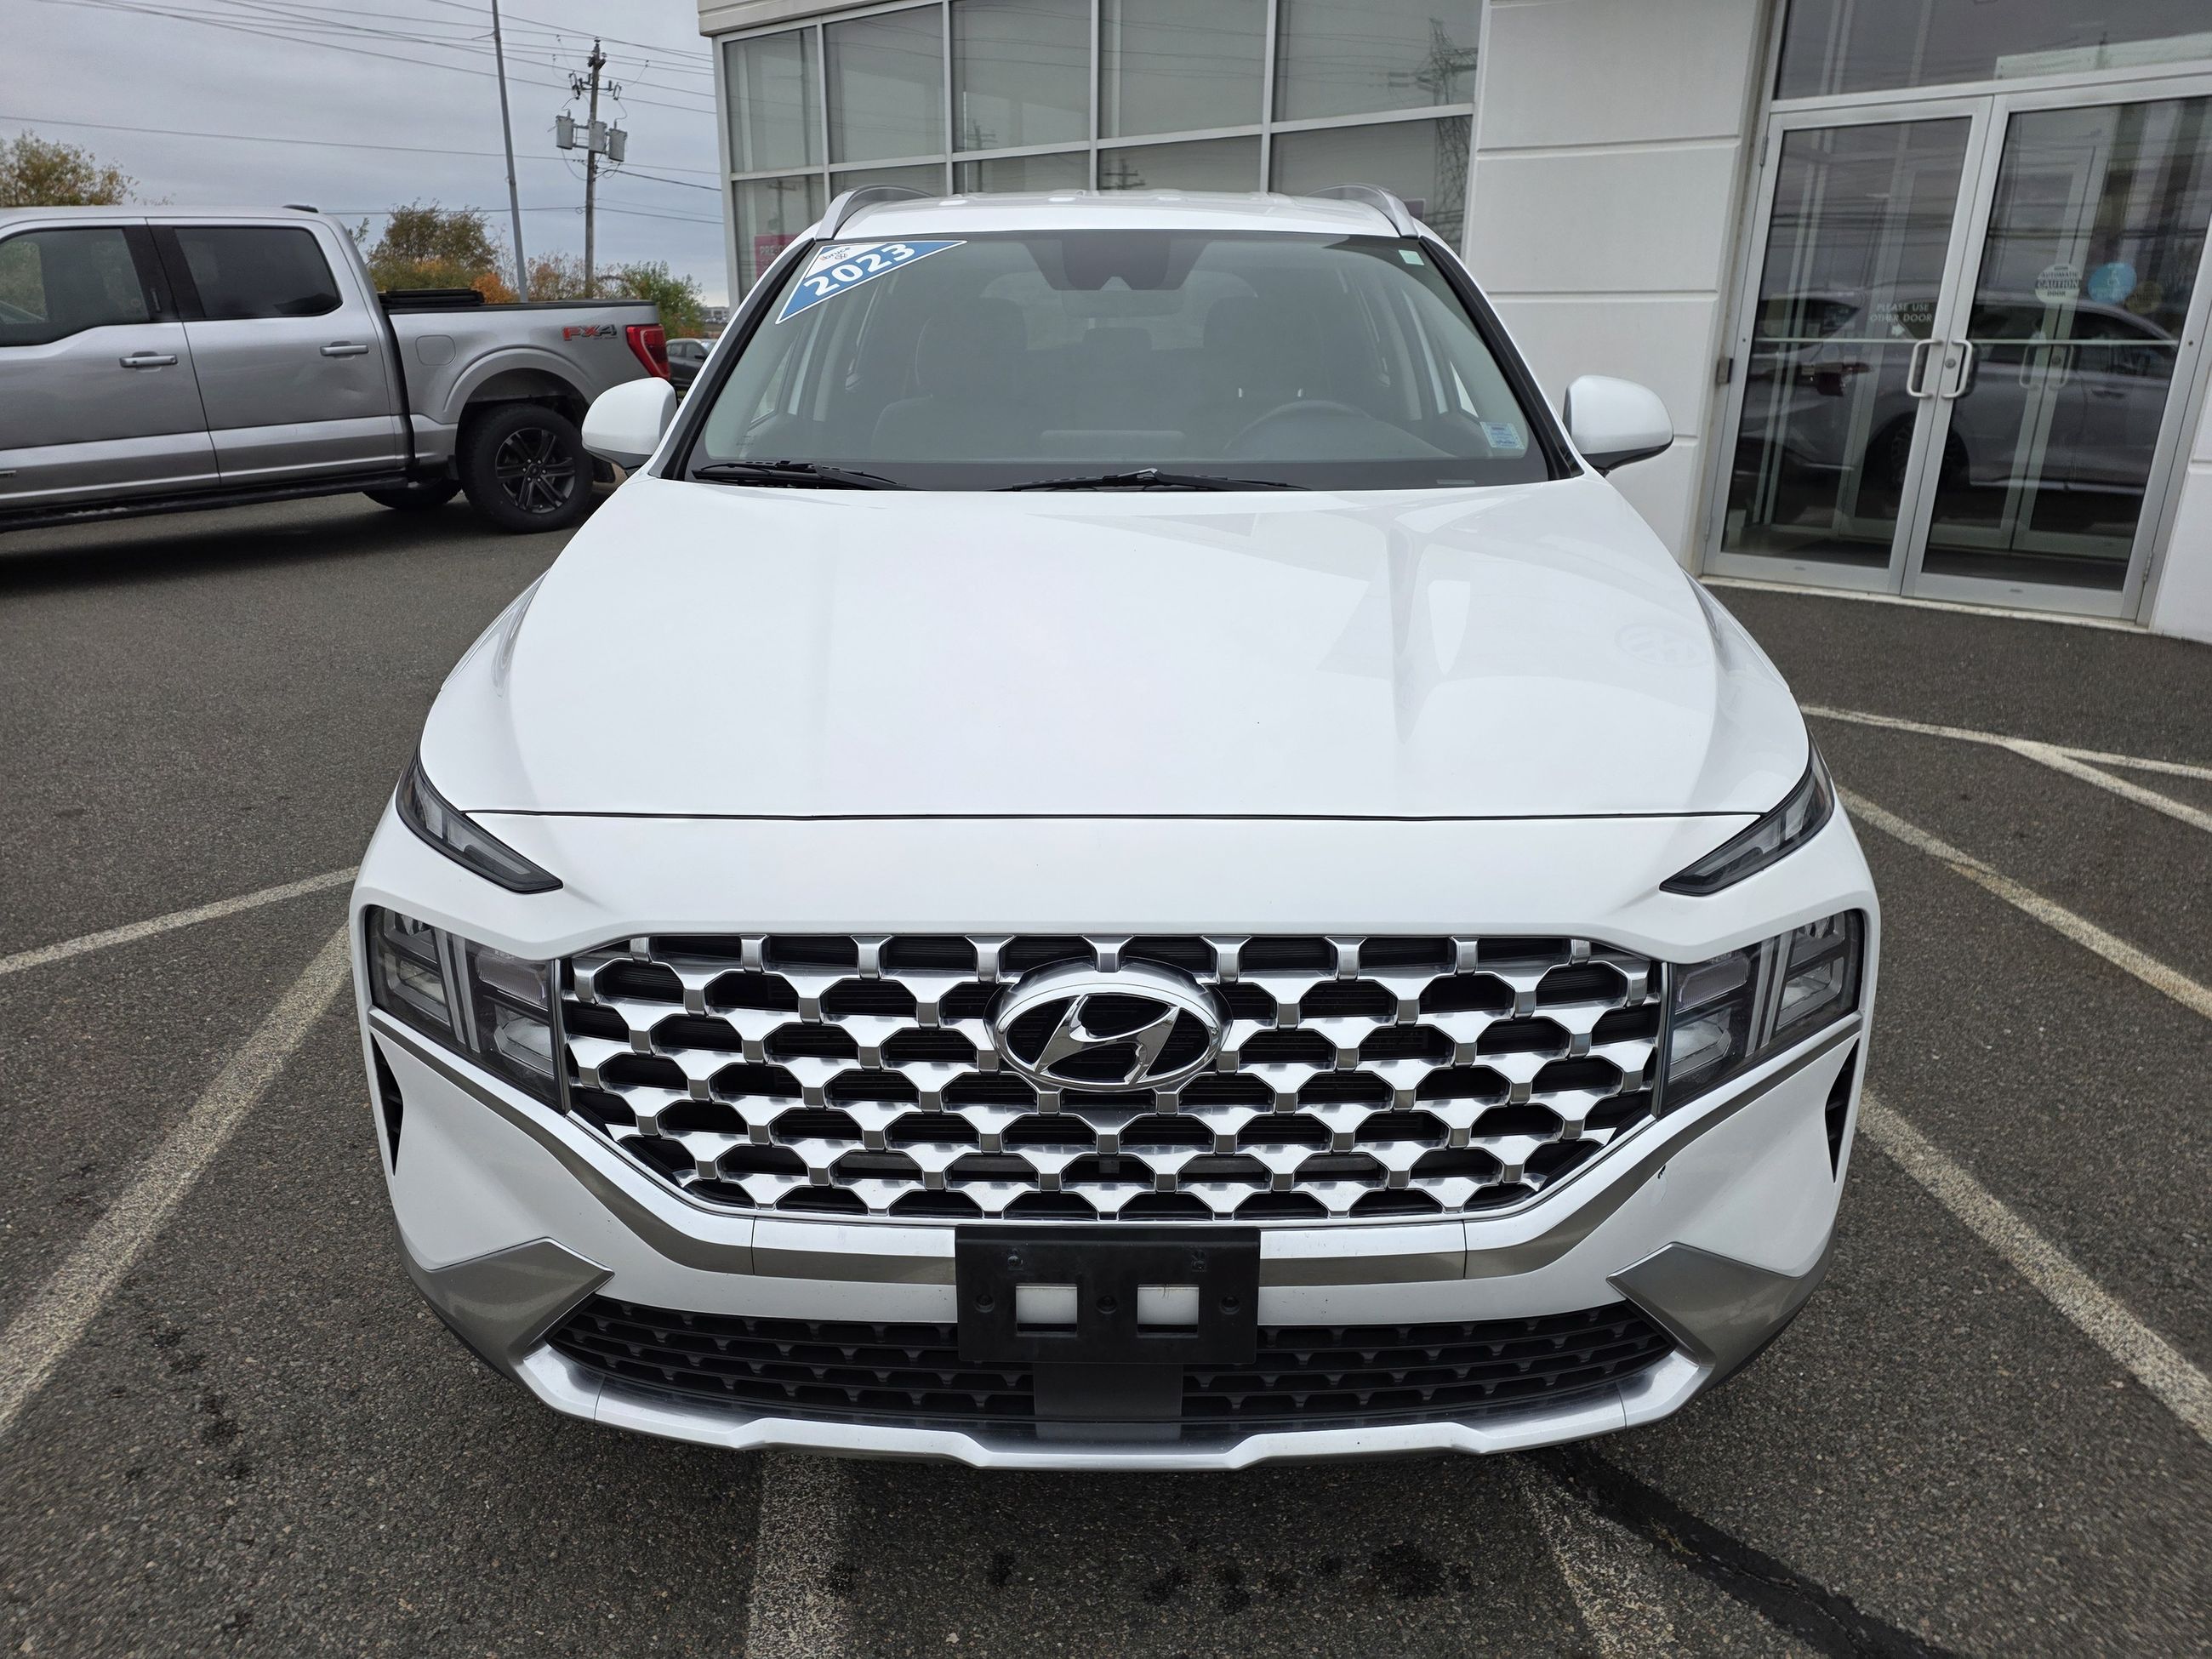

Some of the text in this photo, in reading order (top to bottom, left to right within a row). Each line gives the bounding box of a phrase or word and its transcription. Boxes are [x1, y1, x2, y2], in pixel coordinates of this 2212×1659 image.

[803, 243, 915, 297] 2023
[2035, 279, 2081, 289] CAUTION
[1876, 301, 1930, 312] PLEASE USE
[1870, 312, 1933, 322] OTHER DOOR
[562, 324, 617, 341] FX4
